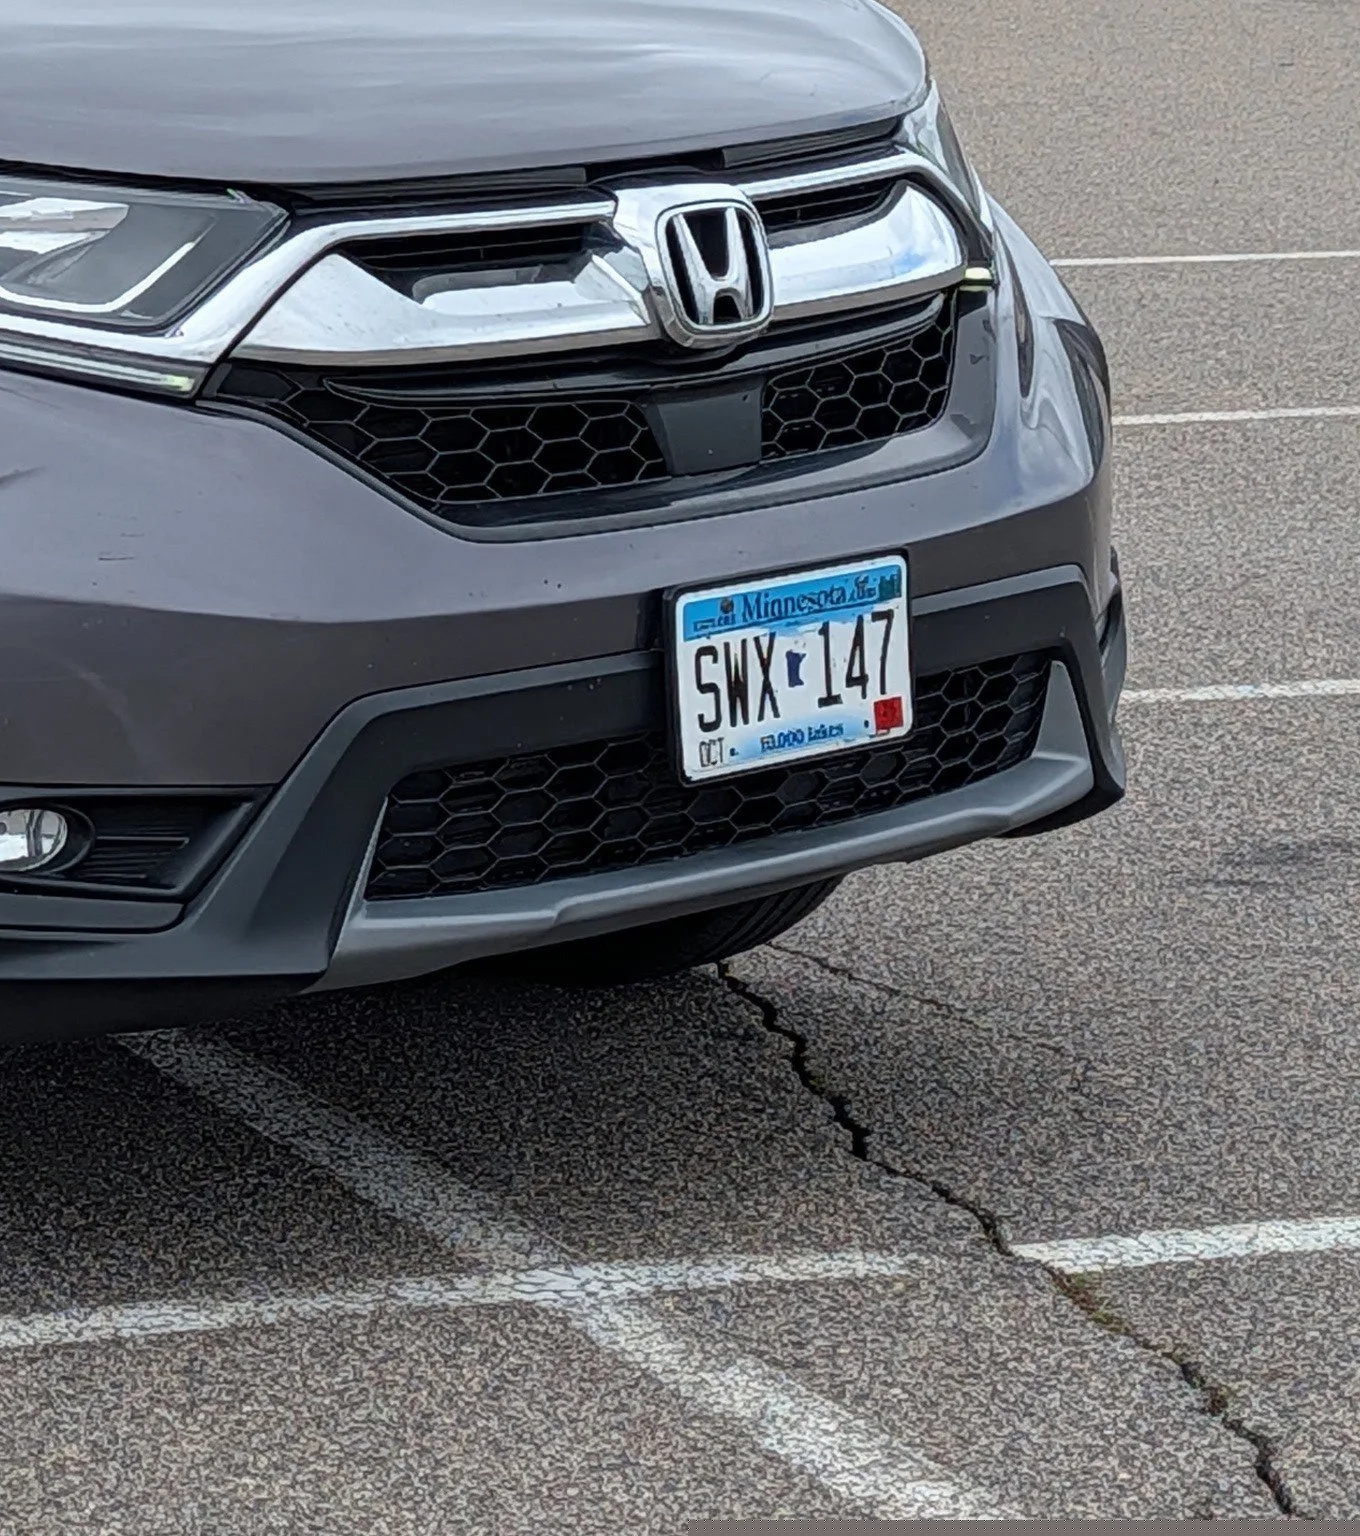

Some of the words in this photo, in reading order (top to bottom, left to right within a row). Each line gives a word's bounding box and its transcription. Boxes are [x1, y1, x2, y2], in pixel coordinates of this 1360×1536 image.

[742, 585, 847, 622] Minnesota
[694, 631, 780, 733] SWX
[817, 608, 895, 708] 147
